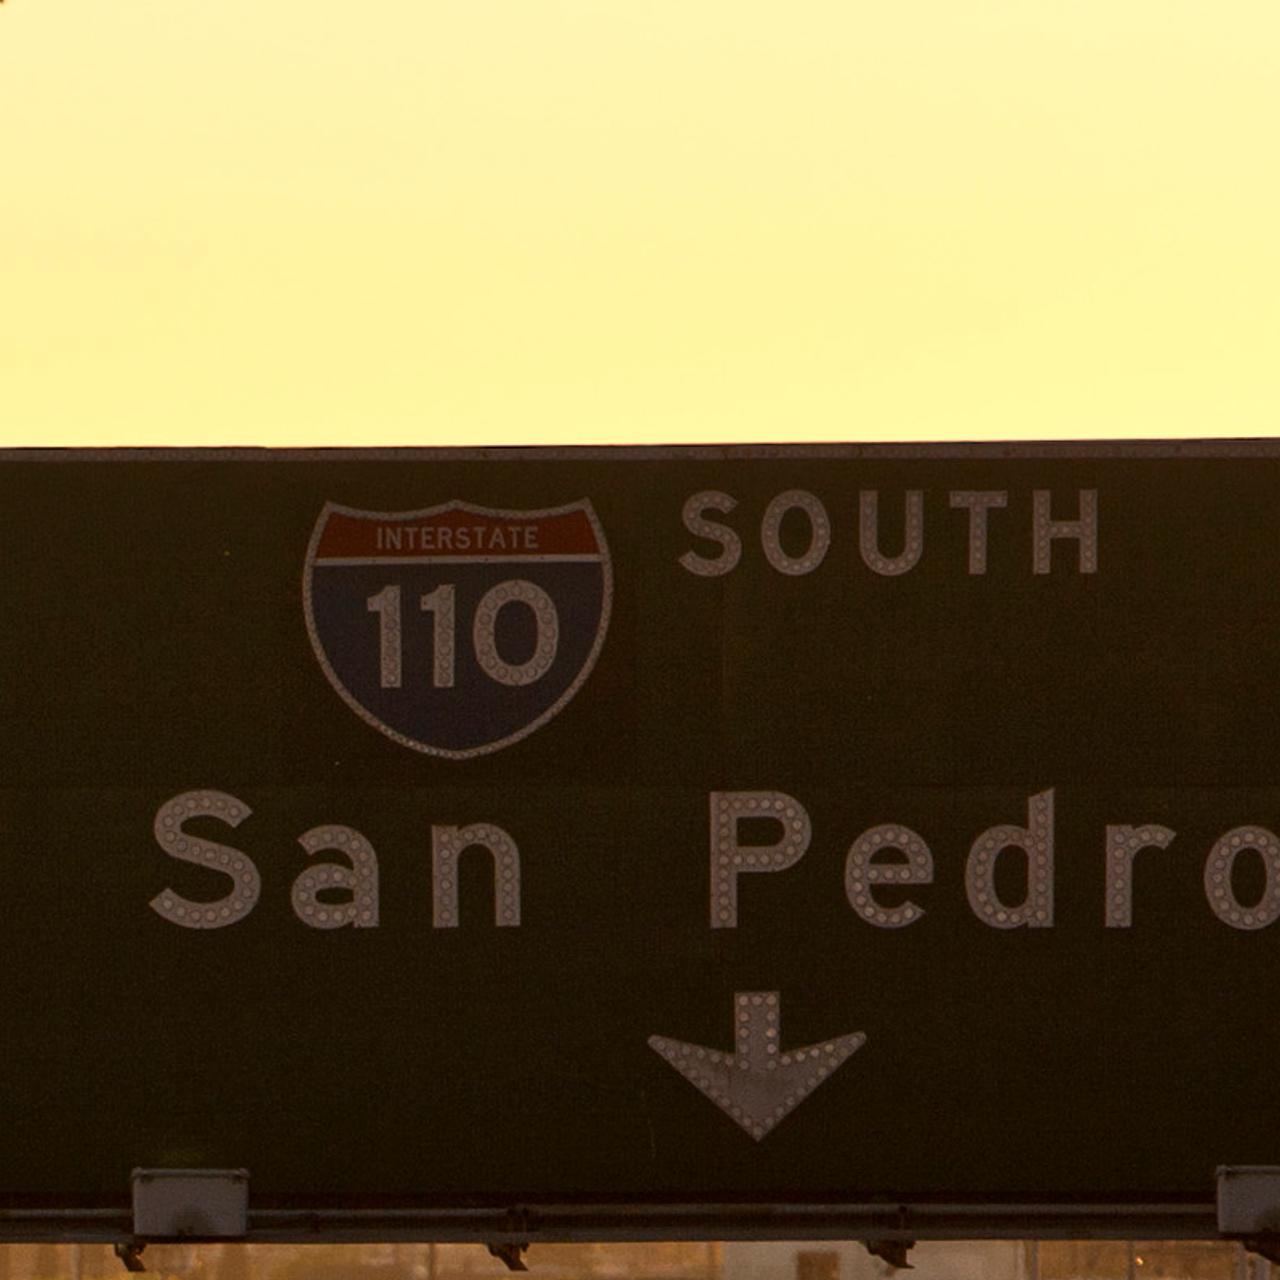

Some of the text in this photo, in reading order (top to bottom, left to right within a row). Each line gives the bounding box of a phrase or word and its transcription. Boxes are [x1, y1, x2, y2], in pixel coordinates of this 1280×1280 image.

[376, 526, 539, 549] INTERSTATE
[677, 489, 1099, 578] SOUTH
[366, 579, 559, 688] 110
[148, 788, 1280, 931] San Pedro
